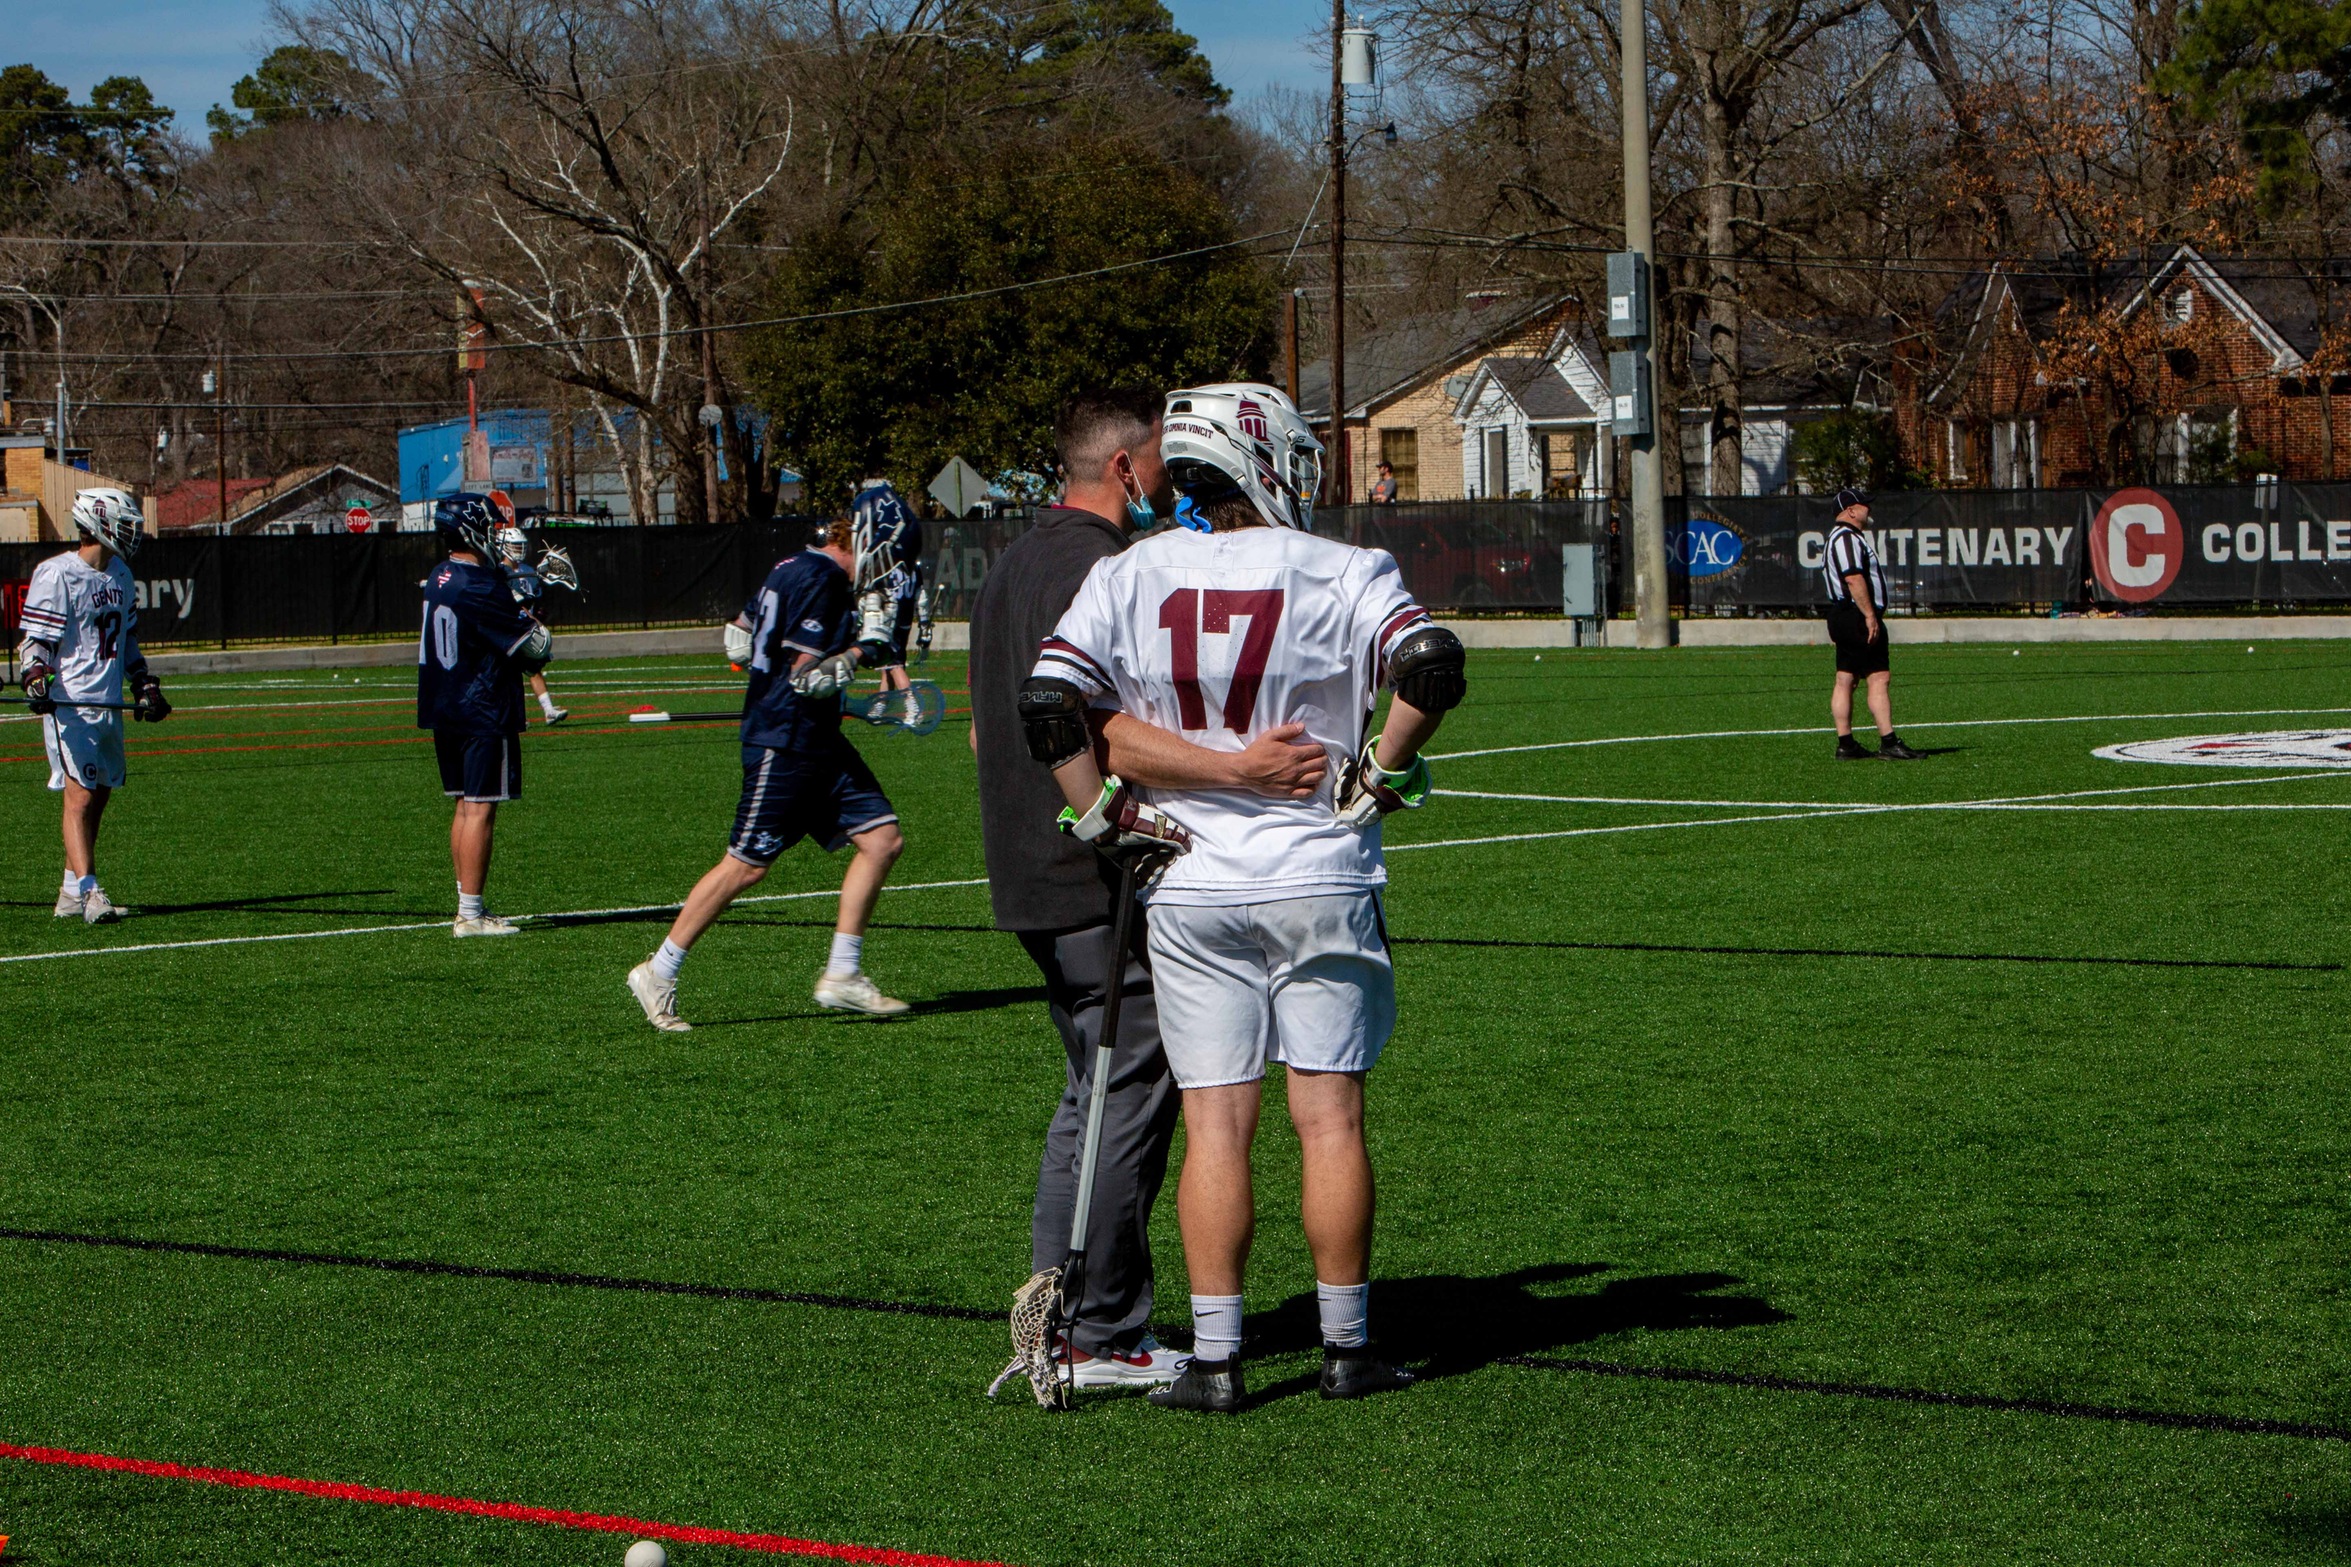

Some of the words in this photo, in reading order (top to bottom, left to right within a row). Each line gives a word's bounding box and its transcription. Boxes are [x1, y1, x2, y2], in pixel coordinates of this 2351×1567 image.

[1189, 424, 1214, 439] VINCIT
[347, 515, 370, 526] STOP
[1798, 526, 2073, 568] CNTENARY
[92, 588, 123, 609] GENTS
[94, 611, 122, 660] 12
[1158, 587, 1285, 735] 17
